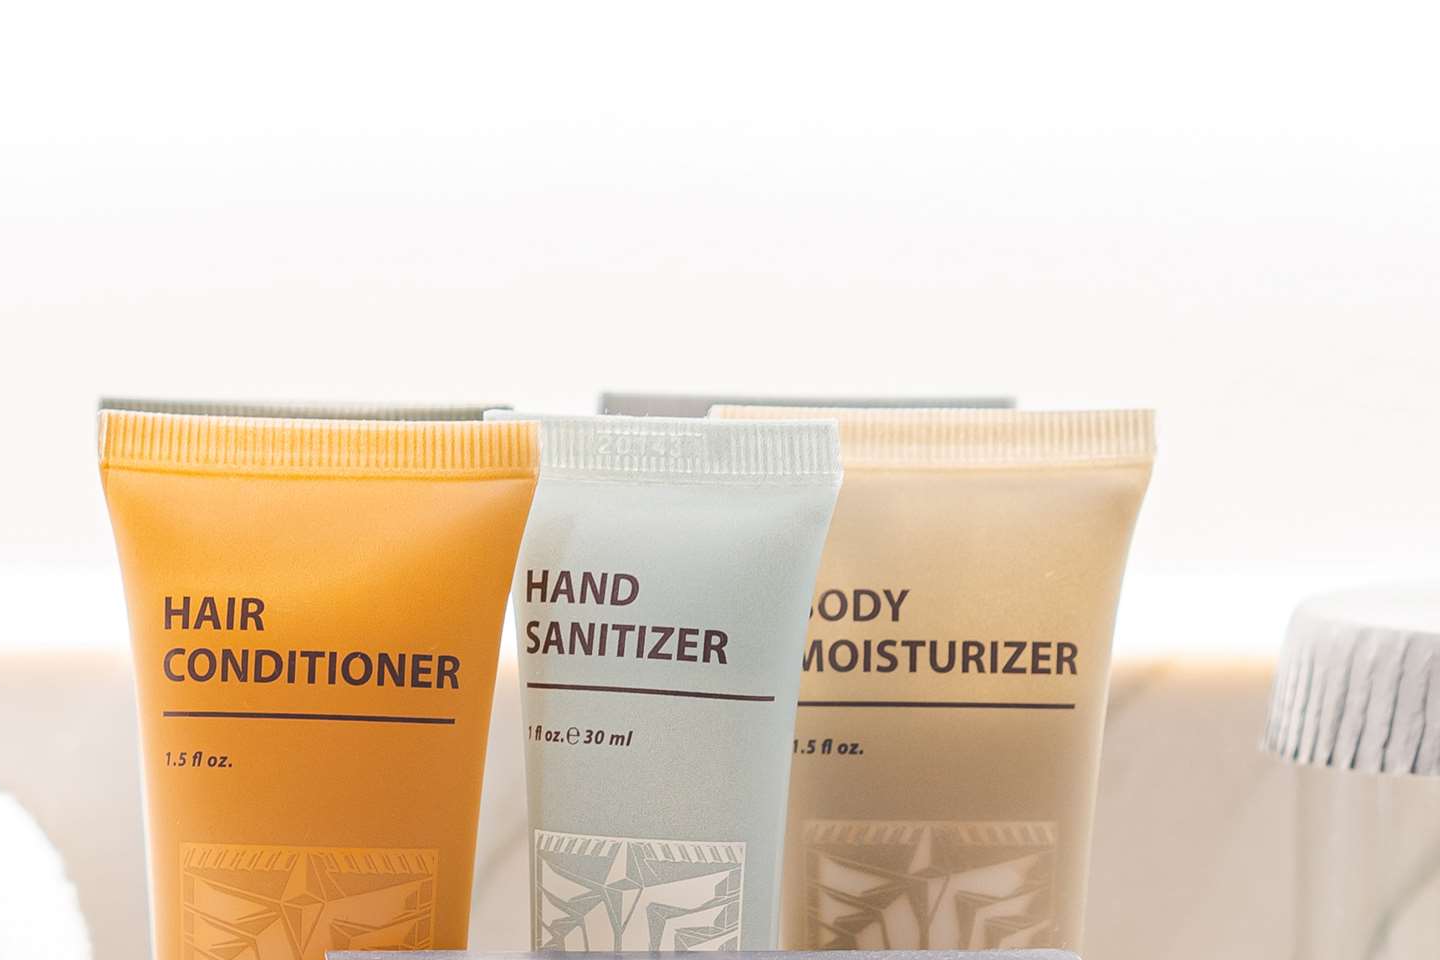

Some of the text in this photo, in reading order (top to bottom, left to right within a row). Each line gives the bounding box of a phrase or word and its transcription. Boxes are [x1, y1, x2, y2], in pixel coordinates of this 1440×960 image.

[526, 570, 640, 606] HAND
[809, 589, 910, 622] ODY
[163, 596, 265, 631] HAIR
[526, 620, 729, 665] SANITIZER
[802, 639, 1078, 675] MOISTURIZER
[163, 648, 460, 689] CONDITIONER
[583, 729, 605, 745] 30
[609, 730, 633, 747] ml
[793, 738, 864, 756] 1.5 fl oz.
[165, 751, 233, 768] 1.5 fl oz.
